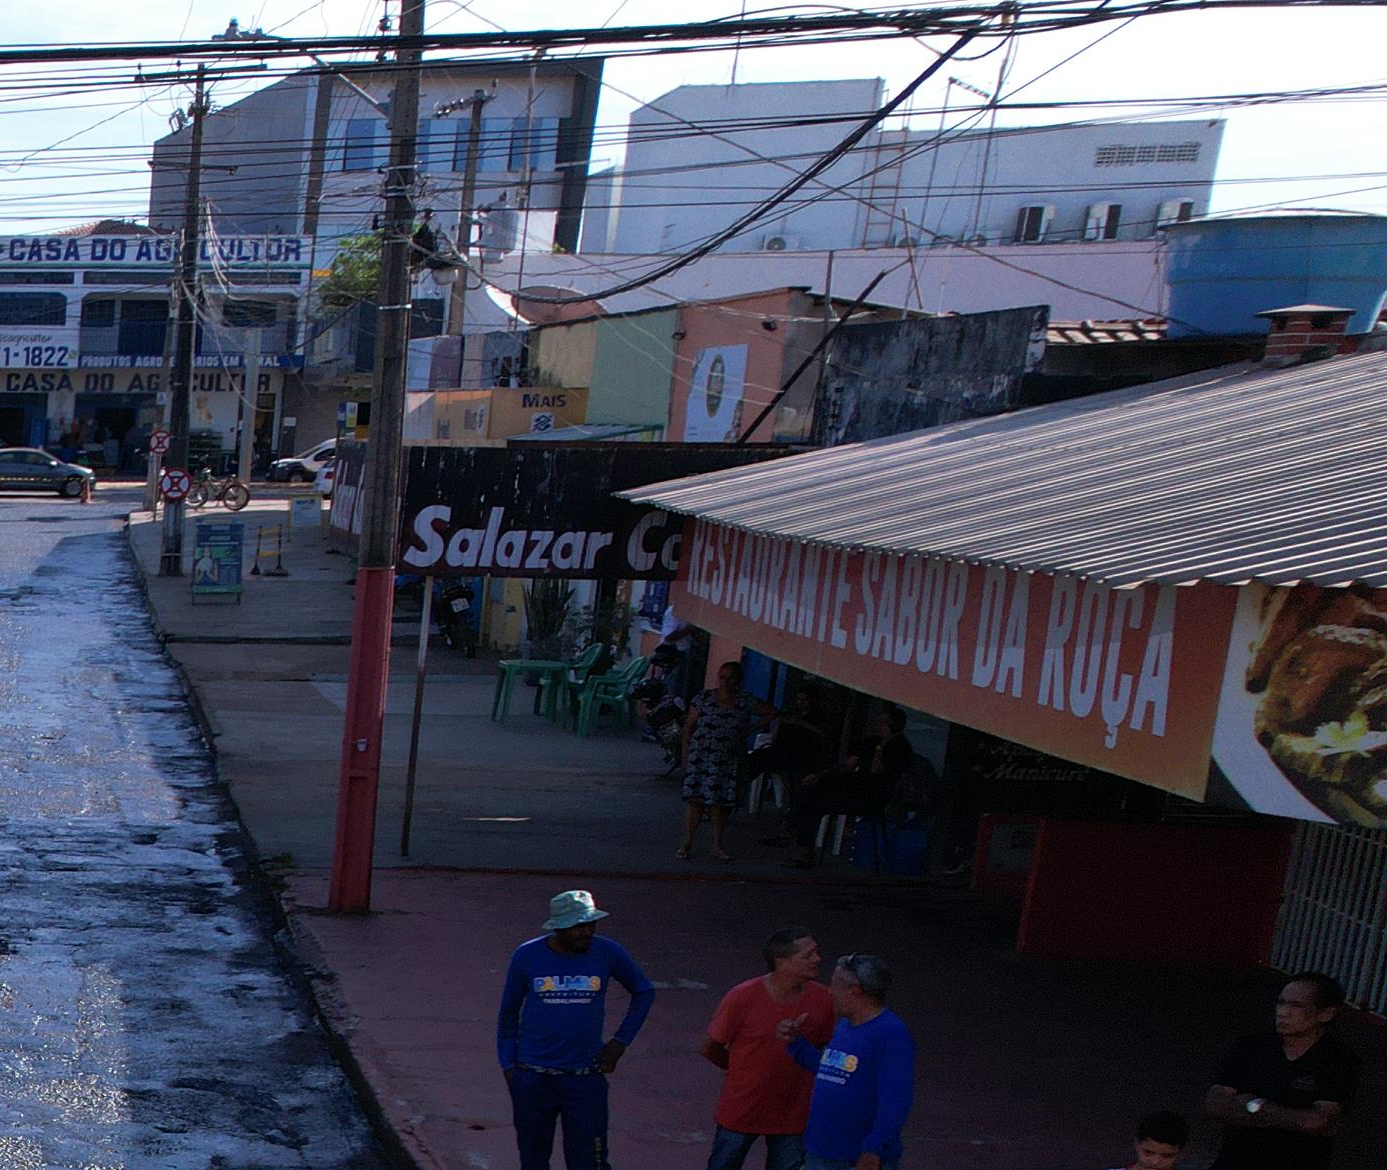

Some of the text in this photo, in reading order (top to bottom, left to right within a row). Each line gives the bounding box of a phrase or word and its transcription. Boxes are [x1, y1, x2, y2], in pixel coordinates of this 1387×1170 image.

[9, 238, 81, 261] CASA
[91, 238, 126, 261] DO
[135, 238, 302, 262] AGCULTOR
[81, 355, 132, 368] PRODUTOS
[6, 372, 74, 392] CASA
[85, 373, 115, 392] DO
[522, 393, 567, 408] MAIS
[403, 505, 613, 571] Salazar
[687, 517, 1179, 749] RESTAURANTE SABOR DA ROÇA
